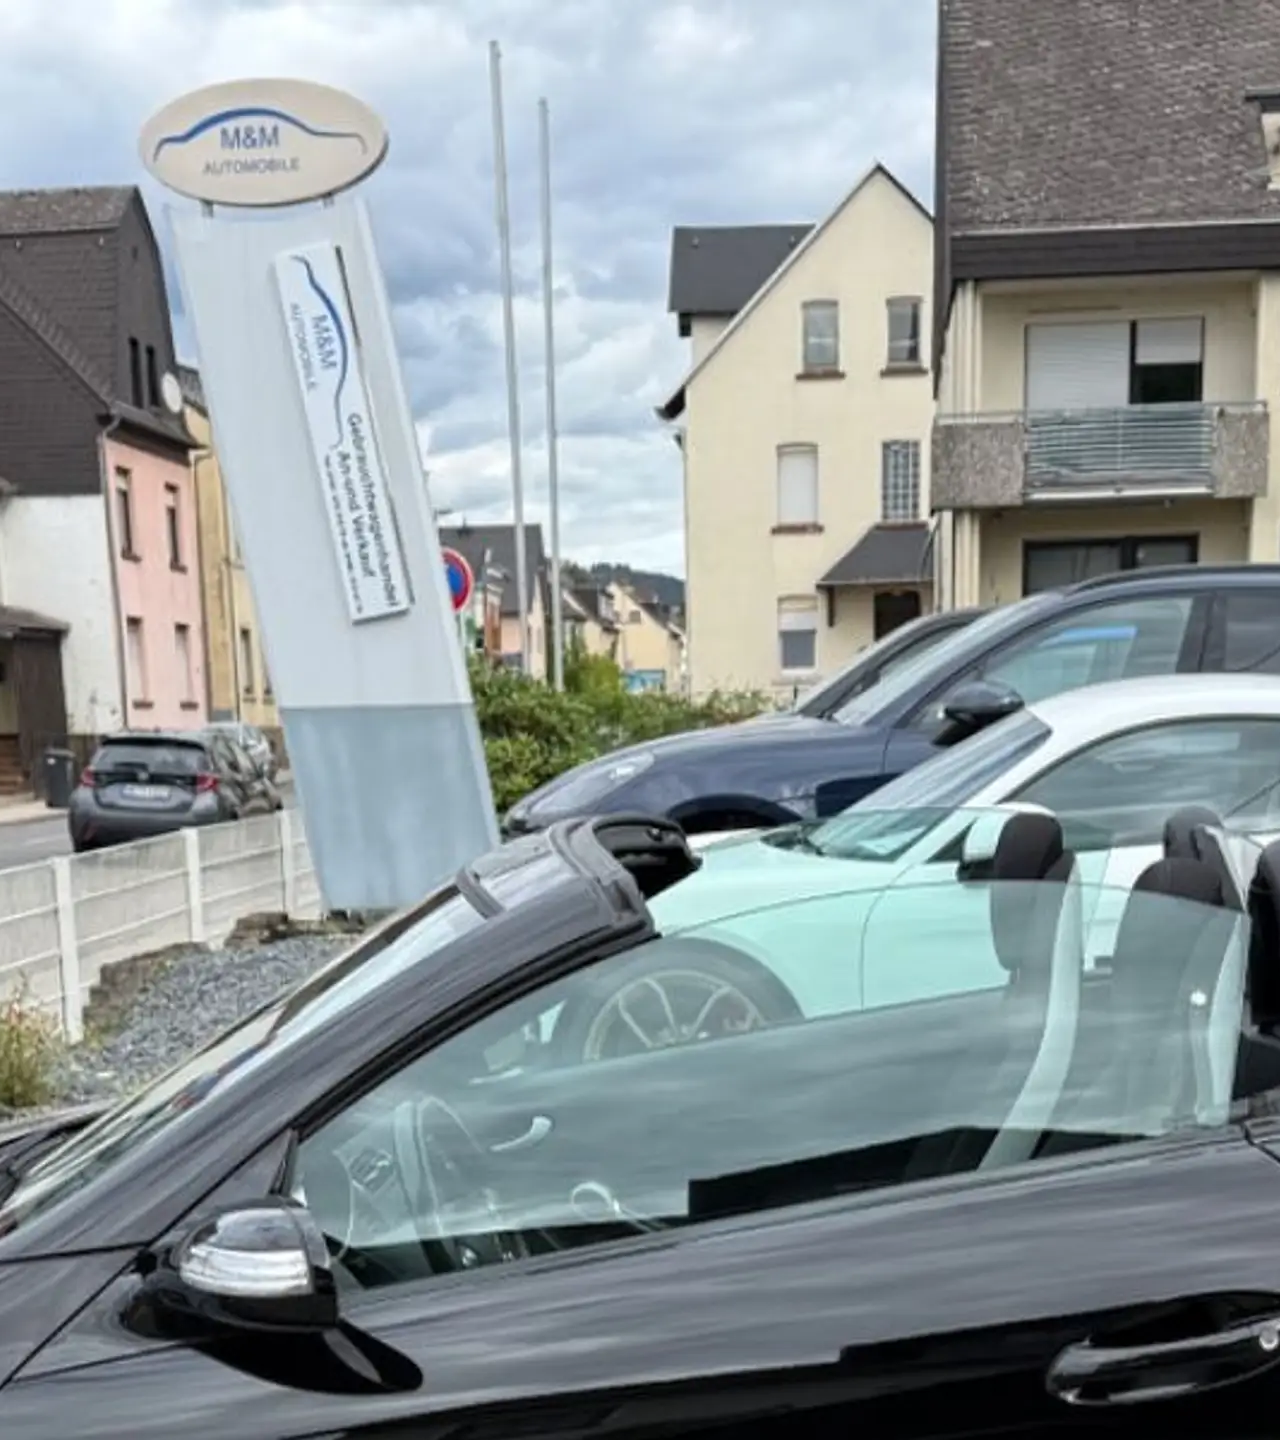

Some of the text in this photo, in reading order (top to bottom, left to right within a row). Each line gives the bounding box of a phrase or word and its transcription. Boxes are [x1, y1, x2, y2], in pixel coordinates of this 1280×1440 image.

[220, 124, 280, 150] M&M
[202, 156, 301, 176] AUTOMOBILE
[311, 313, 338, 371] M&M
